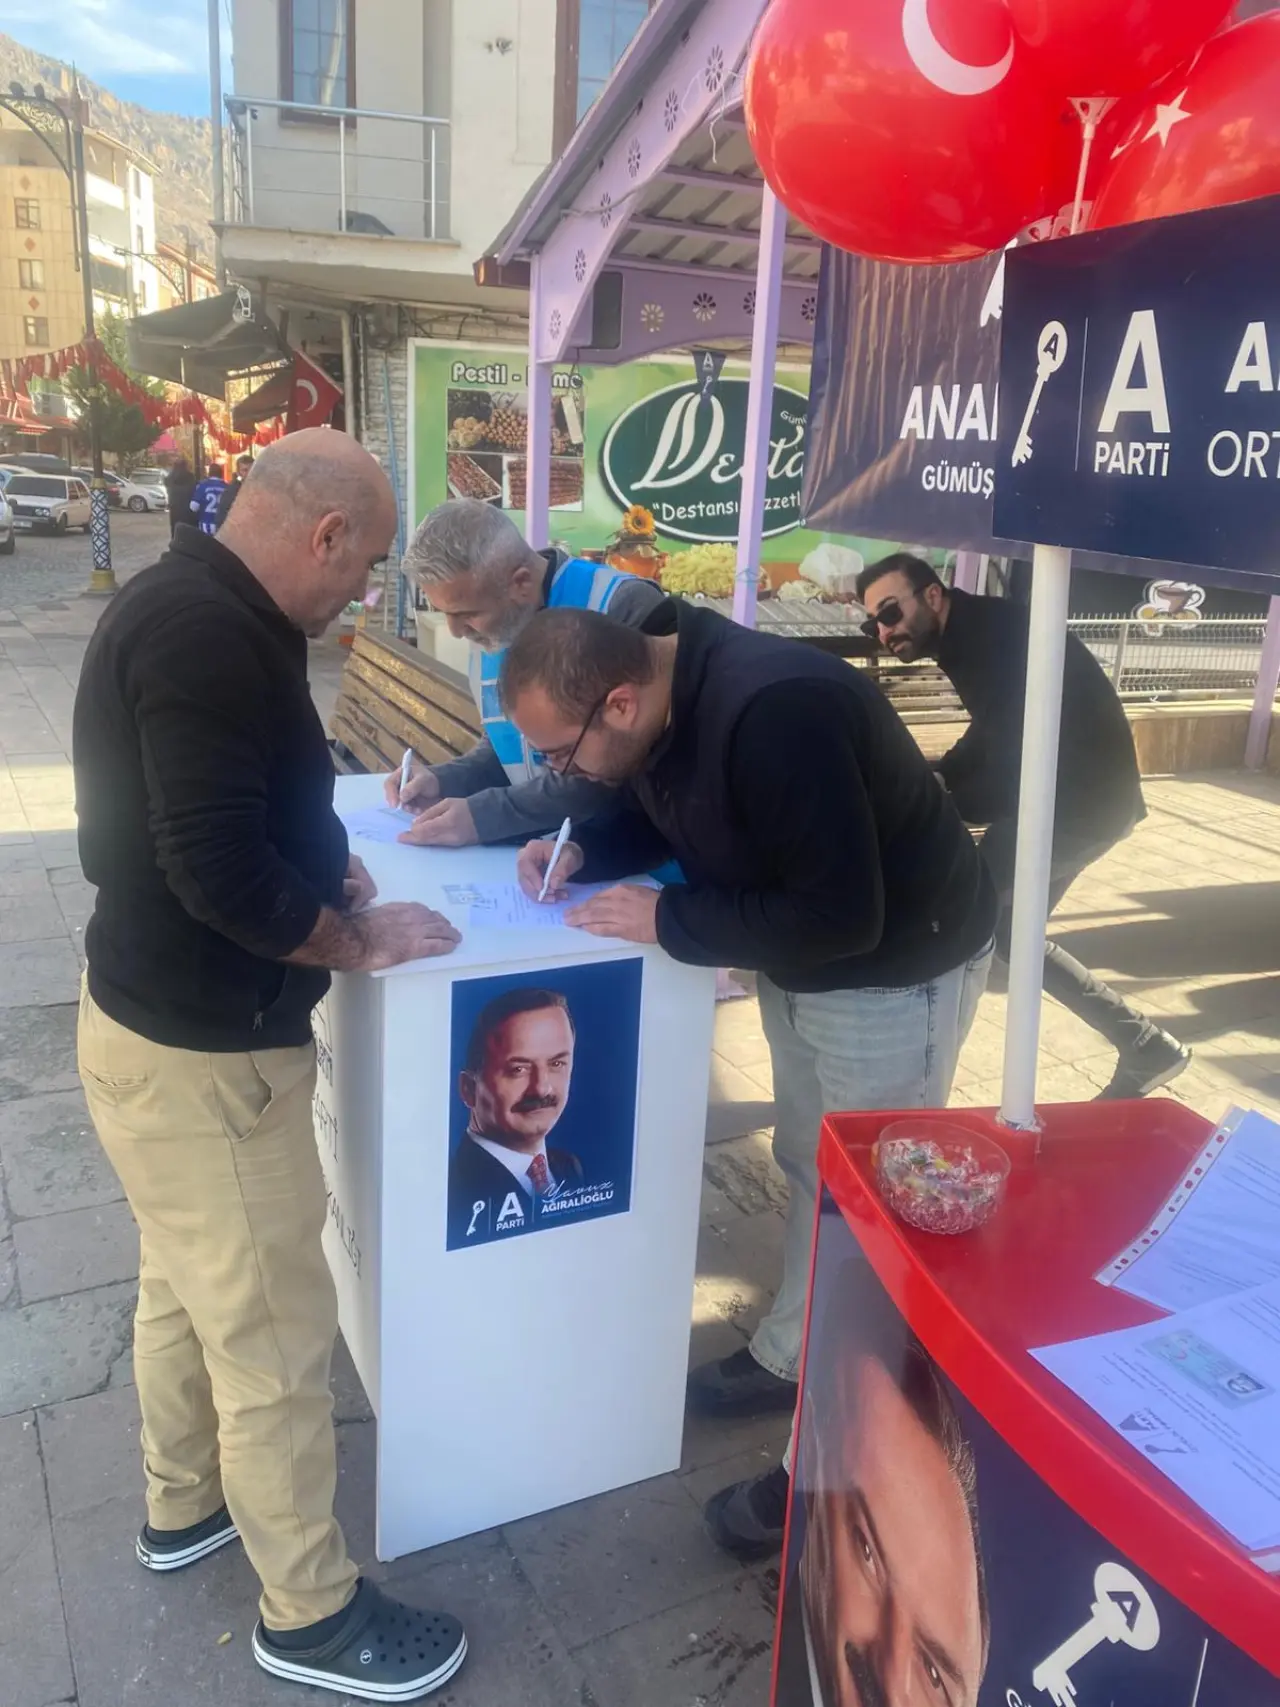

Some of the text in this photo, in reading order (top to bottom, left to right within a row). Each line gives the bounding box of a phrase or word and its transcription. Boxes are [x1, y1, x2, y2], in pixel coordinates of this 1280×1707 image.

[452, 361, 507, 384] Pestil
[1098, 309, 1171, 433] A
[1224, 321, 1280, 393] A
[497, 1191, 524, 1223] A
